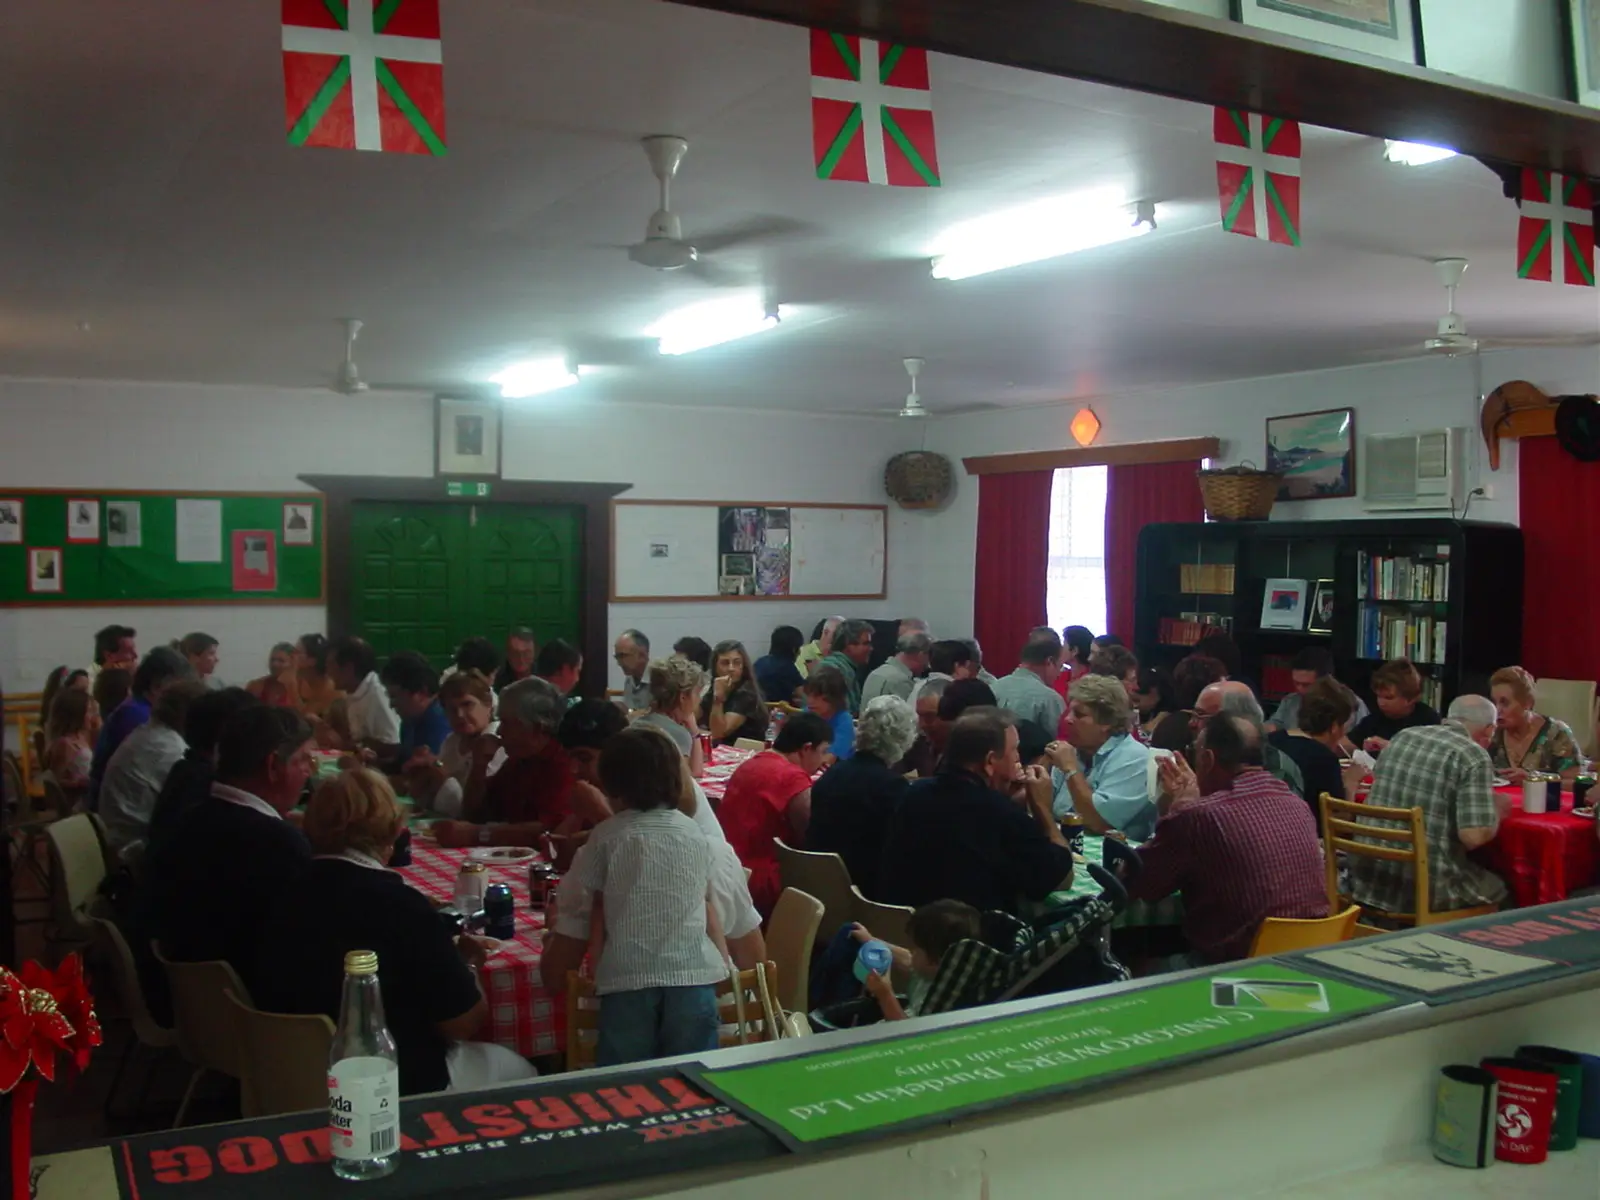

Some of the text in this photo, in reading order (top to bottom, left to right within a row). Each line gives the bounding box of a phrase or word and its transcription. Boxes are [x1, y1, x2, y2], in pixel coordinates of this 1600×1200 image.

[788, 1011, 1254, 1121] CANEGROWERS Burdekin Ltd
[894, 1026, 1112, 1077] Strength with Unity
[416, 1106, 731, 1159] CRISP WHEAT BEER
[633, 1113, 748, 1143] XXXX
[149, 1127, 335, 1184] DOG
